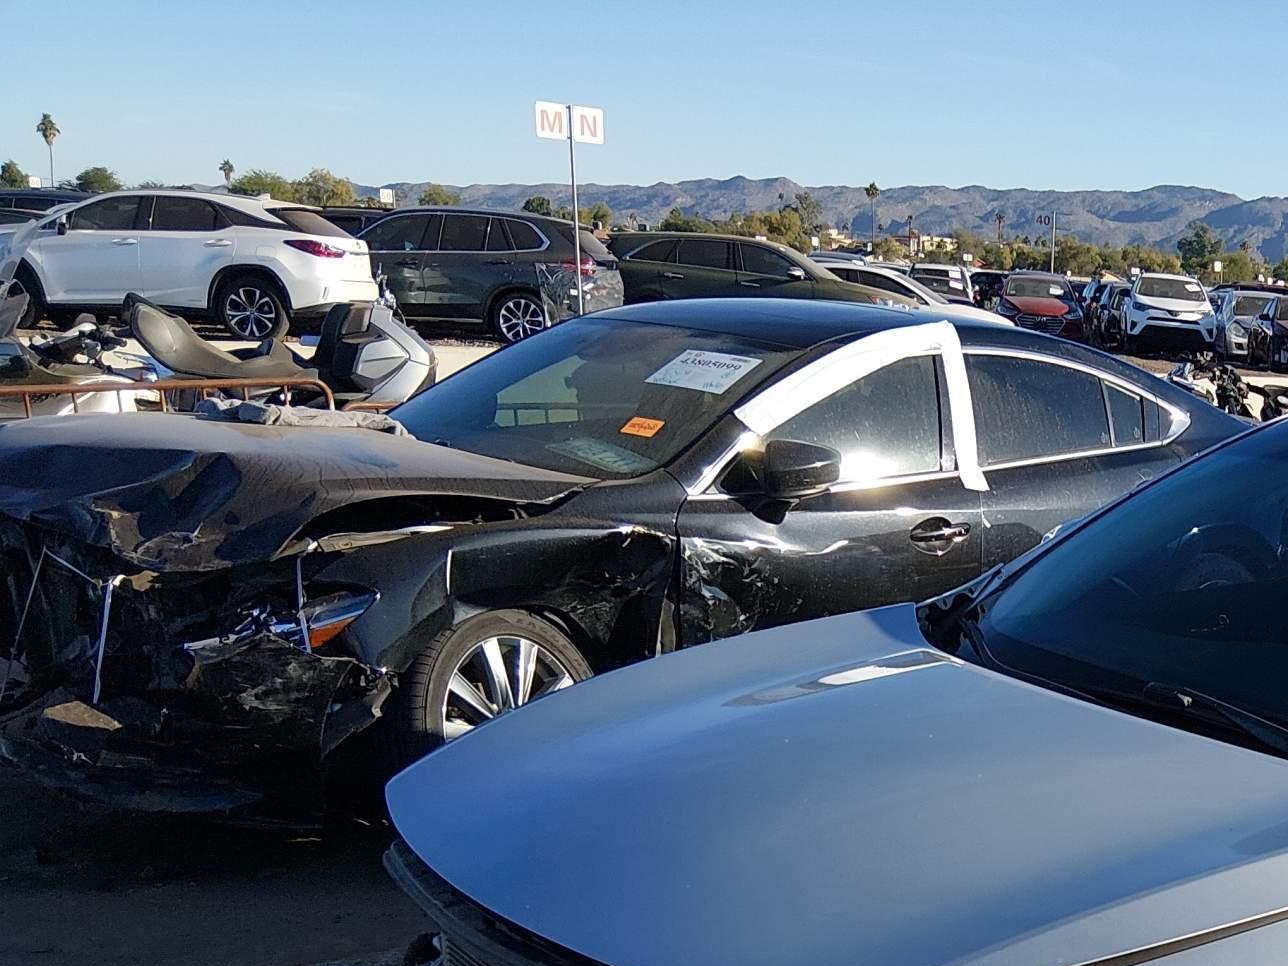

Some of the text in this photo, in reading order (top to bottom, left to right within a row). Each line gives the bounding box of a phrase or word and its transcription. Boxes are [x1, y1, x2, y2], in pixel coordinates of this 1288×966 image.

[540, 109, 563, 134] M
[580, 114, 598, 138] N
[1036, 215, 1050, 226] 40
